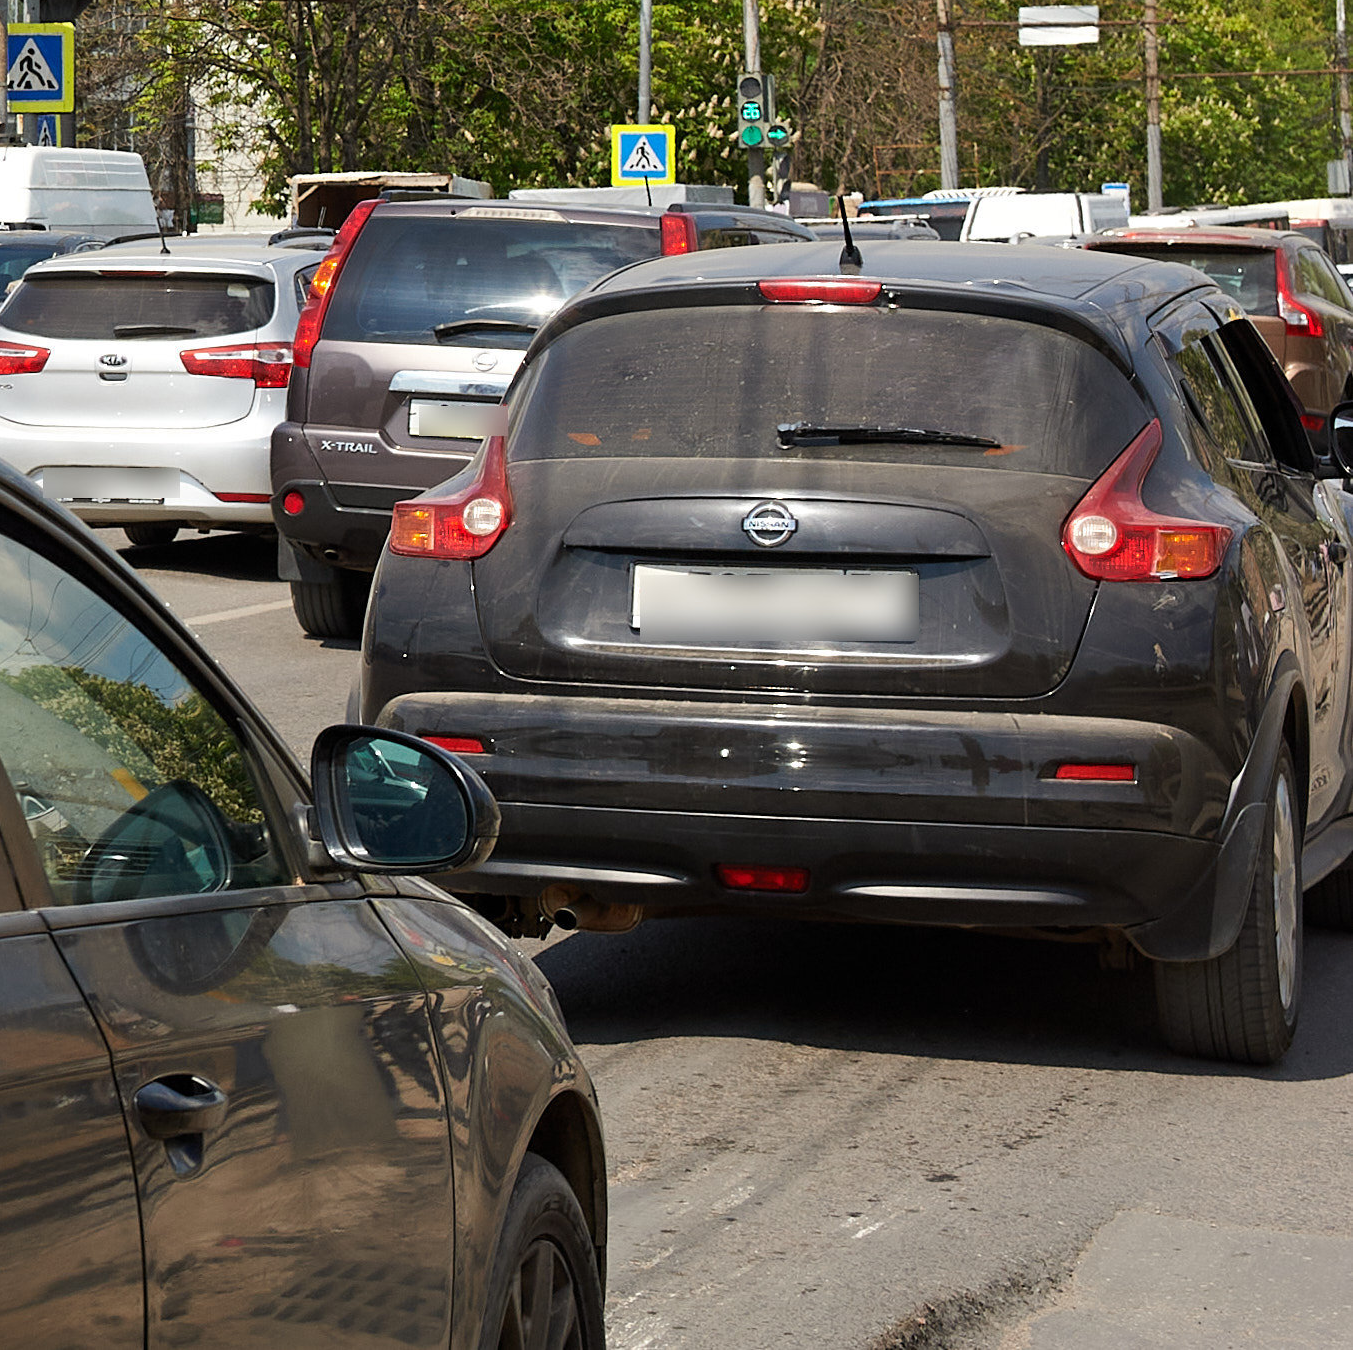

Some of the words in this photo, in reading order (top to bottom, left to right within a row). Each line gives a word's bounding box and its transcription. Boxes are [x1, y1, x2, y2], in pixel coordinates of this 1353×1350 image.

[101, 354, 125, 365] KIA
[321, 440, 378, 454] X-TRAIL
[749, 520, 789, 528] NISSAN
